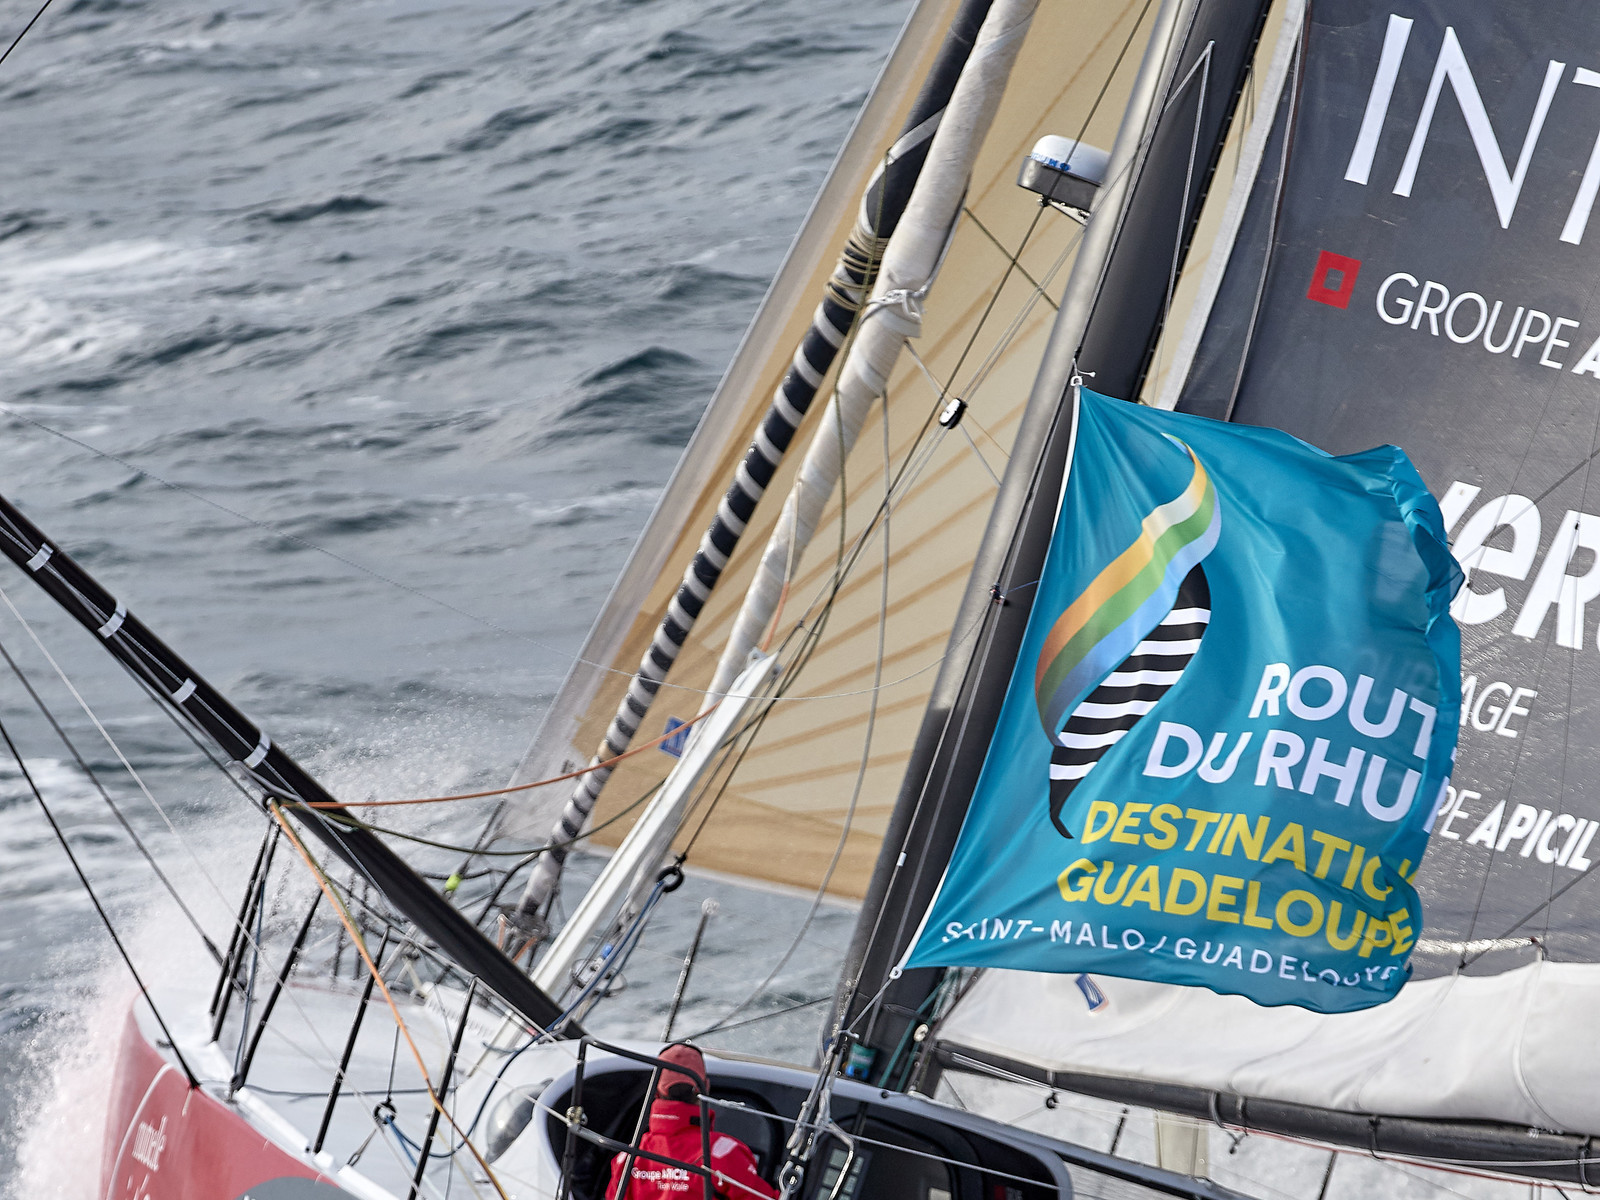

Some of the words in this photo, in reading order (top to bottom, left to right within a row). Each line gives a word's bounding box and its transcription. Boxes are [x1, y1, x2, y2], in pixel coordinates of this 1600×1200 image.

[1376, 272, 1580, 370] GROUPE
[1248, 662, 1440, 760] ROUT
[1143, 721, 1253, 784] DU
[1254, 729, 1449, 834] RHU
[1466, 799, 1600, 872] APICIL
[1057, 858, 1414, 958] GUADELOUPE
